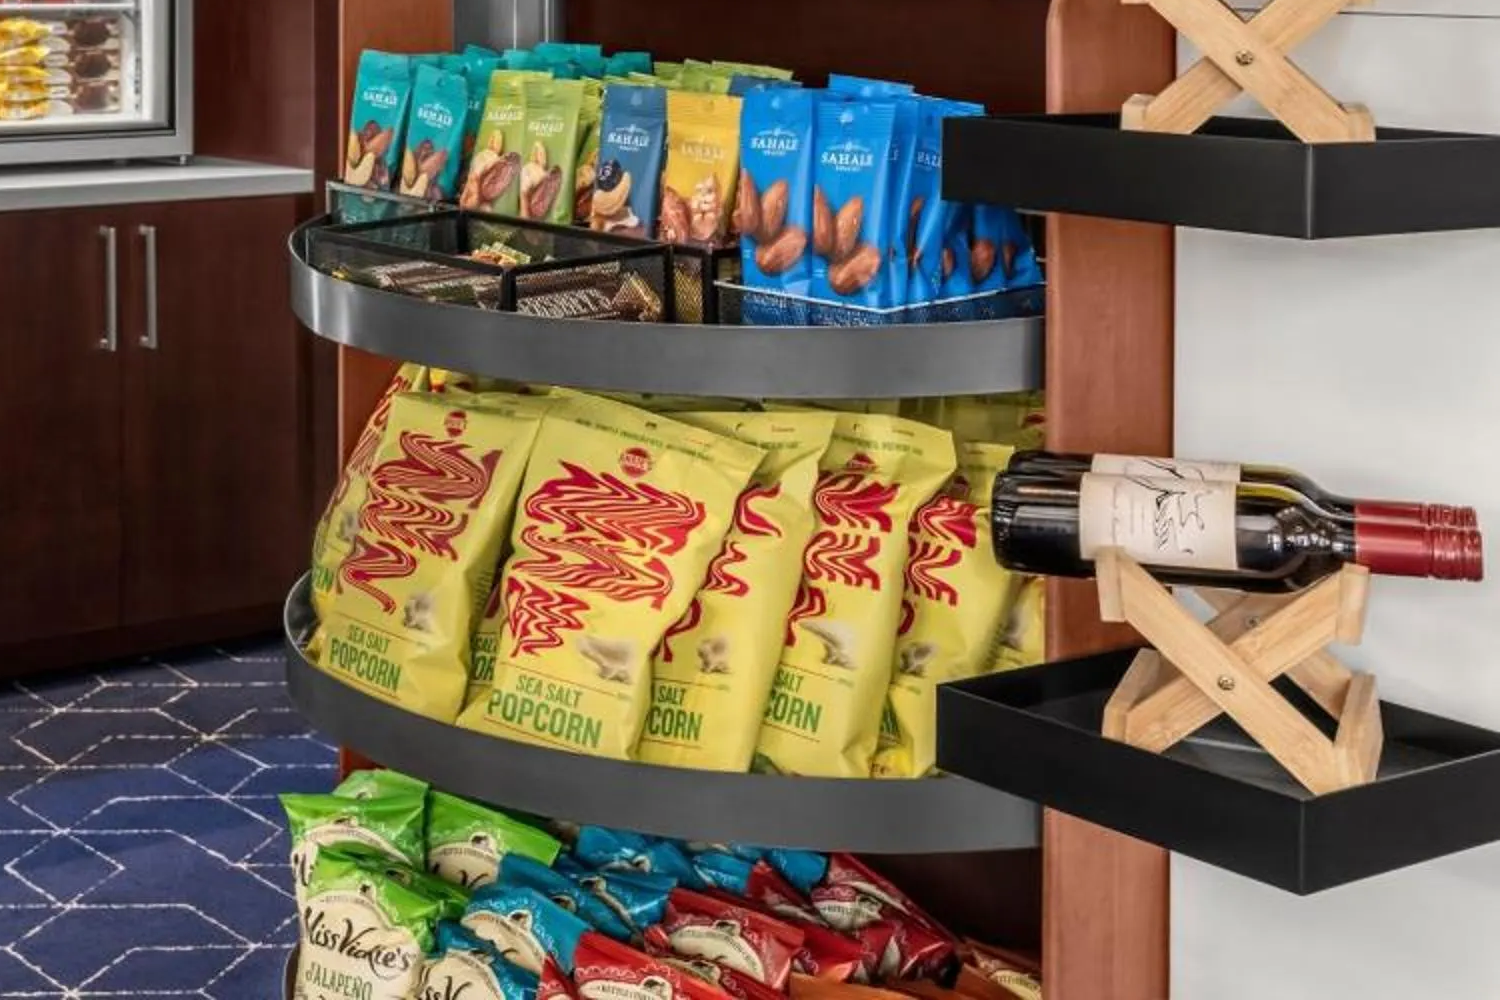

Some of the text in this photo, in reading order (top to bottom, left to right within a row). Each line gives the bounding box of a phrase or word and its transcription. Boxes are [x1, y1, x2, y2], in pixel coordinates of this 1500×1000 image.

[751, 136, 799, 151] SAHALE
[820, 151, 874, 166] SAHALE
[348, 624, 391, 653] SEA SALT
[329, 637, 401, 692] POPCORN
[515, 674, 584, 708] SEA SALT
[657, 685, 687, 706] SALT
[486, 687, 603, 749] POPCORN
[644, 706, 704, 741] CORN
